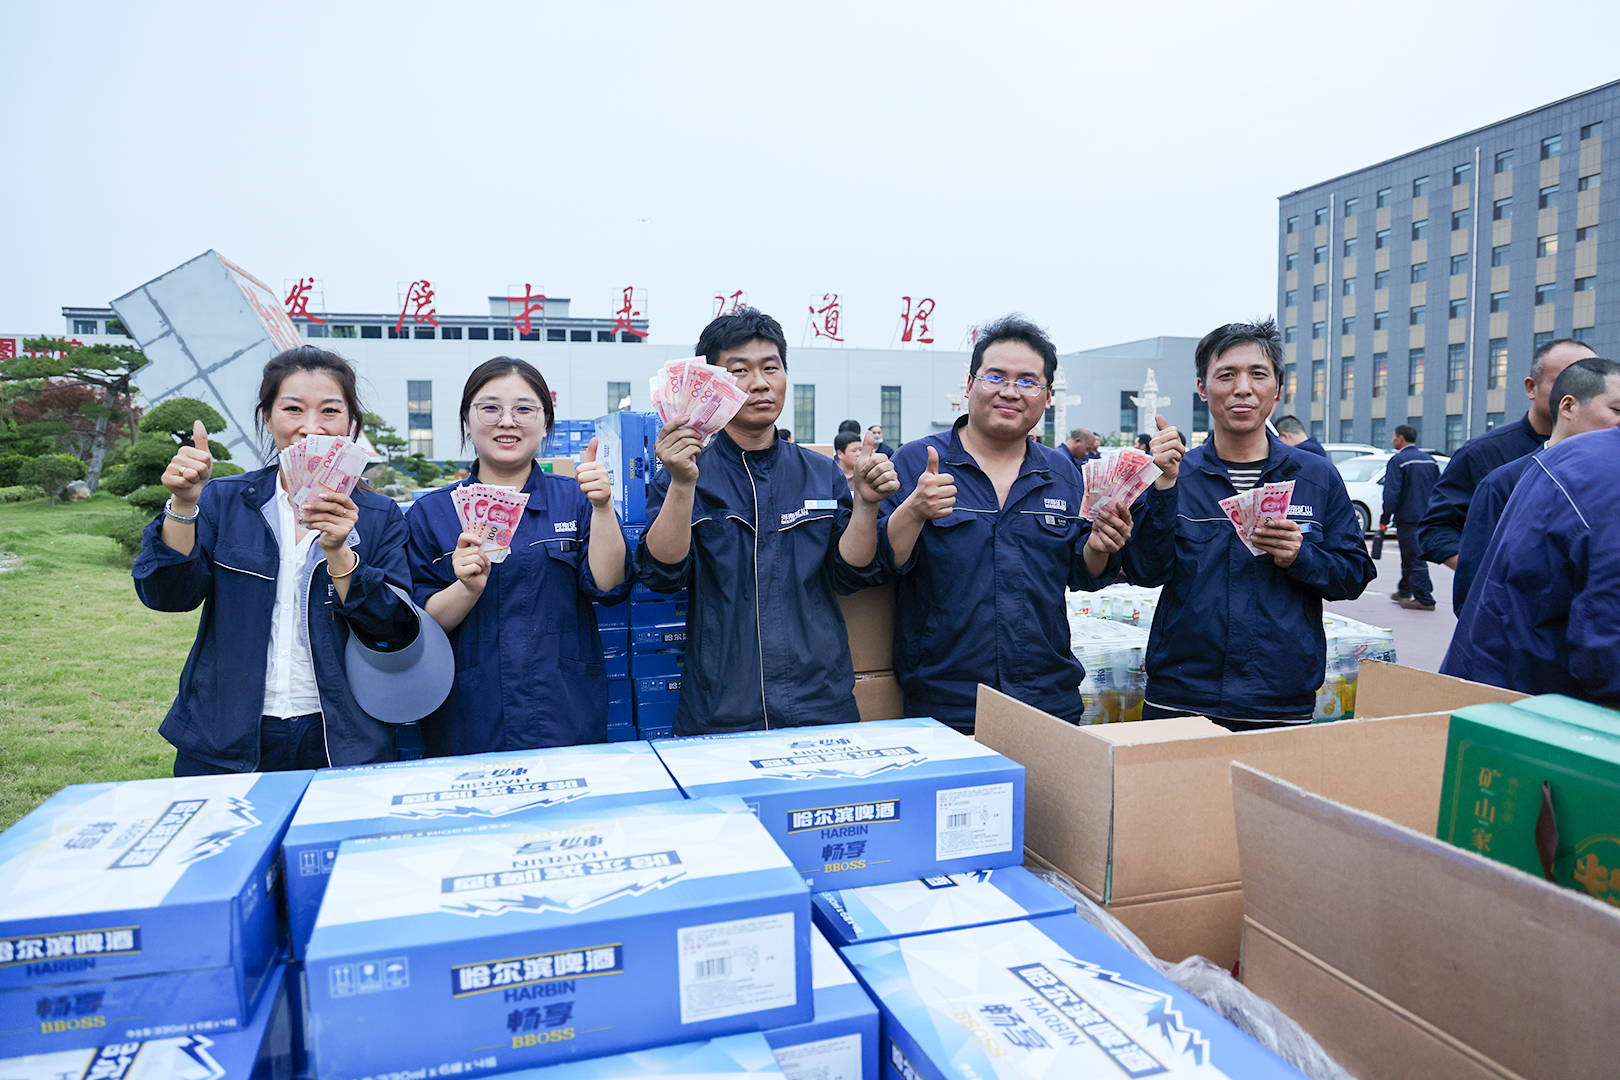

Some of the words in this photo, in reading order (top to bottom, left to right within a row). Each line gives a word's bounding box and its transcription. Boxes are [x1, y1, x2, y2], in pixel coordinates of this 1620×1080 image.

[671, 375, 679, 394] 100
[700, 387, 715, 404] 100
[487, 527, 498, 541] 100
[401, 780, 578, 804] 哈尔滨啤酒
[451, 778, 530, 790] HARBIN
[793, 802, 895, 828] 哈尔滨啤酒
[821, 825, 868, 840] HARBIN
[512, 850, 609, 869] HARBIN
[821, 840, 867, 862] 畅享
[453, 853, 671, 893] 哈尔滨啤酒
[824, 859, 866, 874] BBOSS
[459, 946, 616, 991] 哈尔滨啤酒
[504, 980, 576, 1003] HARBIN
[41, 1015, 106, 1034] BBOSS
[506, 1001, 576, 1034] 畅享
[979, 1003, 1055, 1052] 畅享
[1018, 966, 1160, 1073] 哈尔滨啤酒
[1020, 997, 1086, 1047] HARBIN
[511, 1027, 576, 1049] BBOSS
[953, 1011, 1008, 1058] BBOSS
